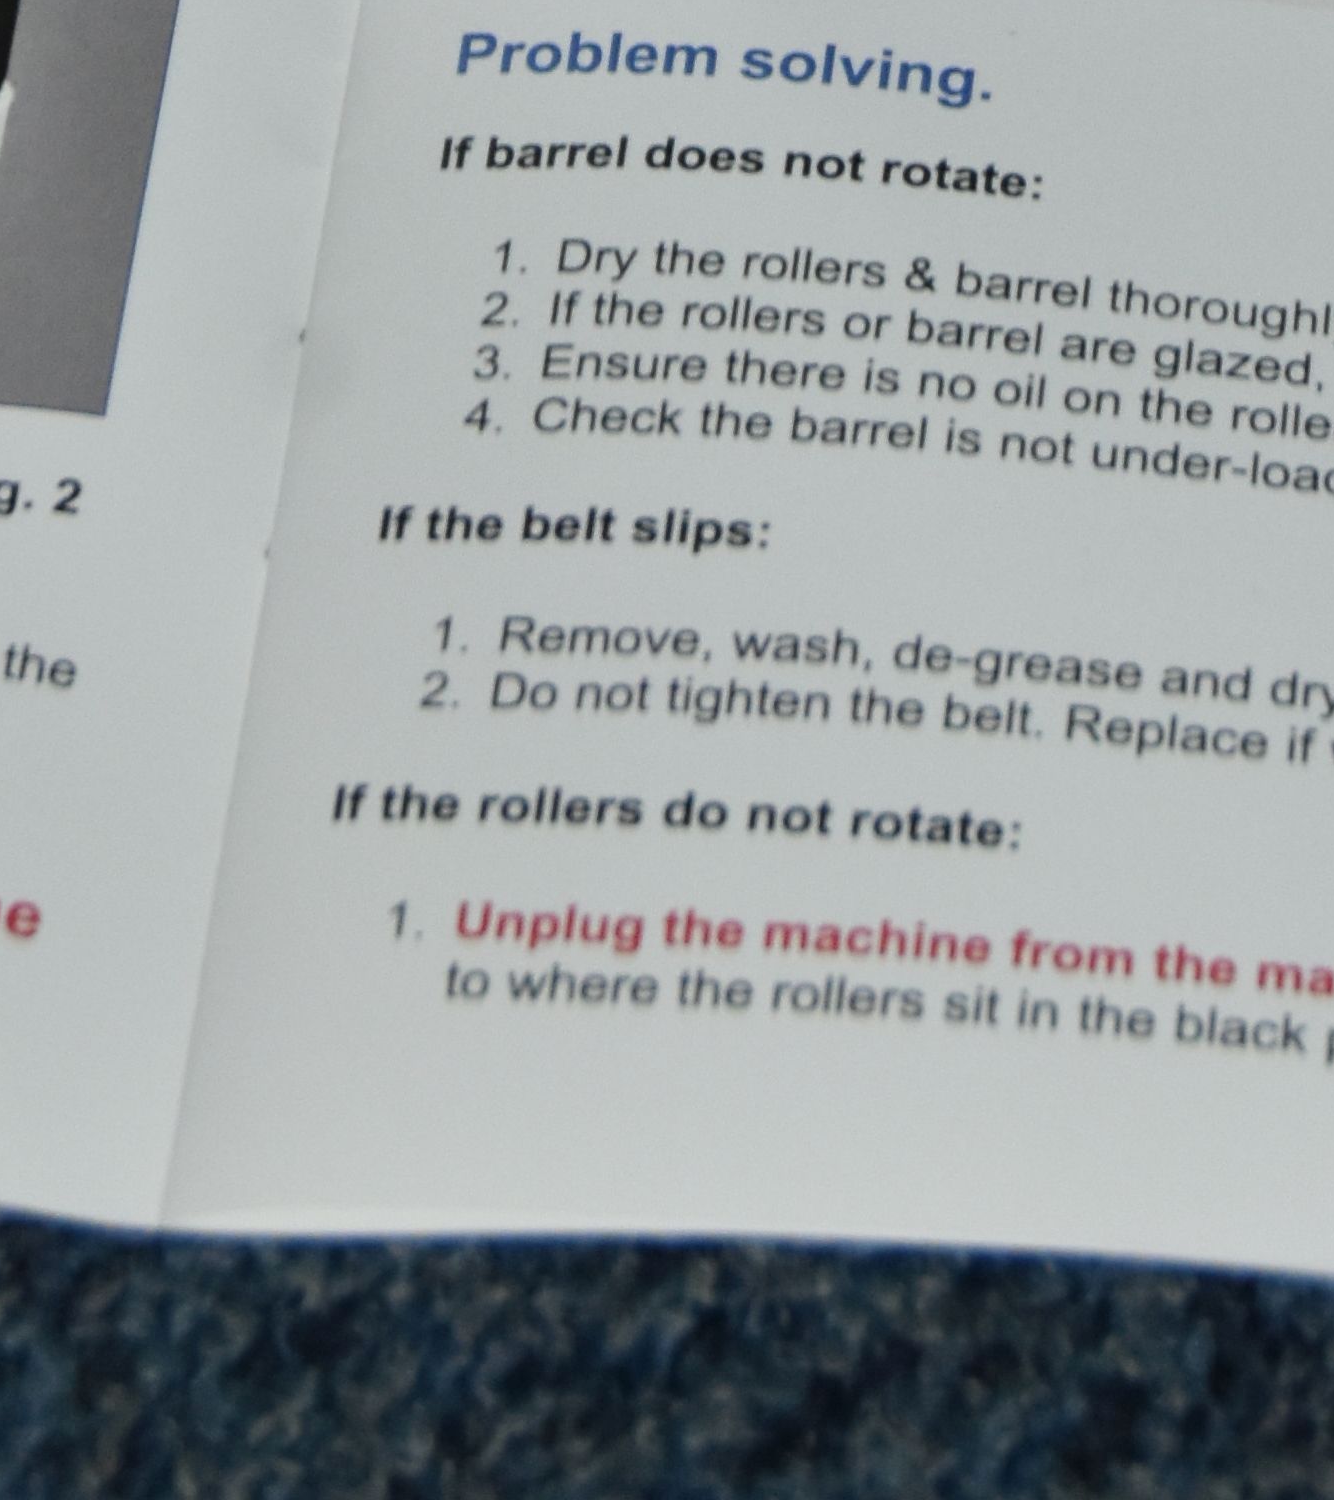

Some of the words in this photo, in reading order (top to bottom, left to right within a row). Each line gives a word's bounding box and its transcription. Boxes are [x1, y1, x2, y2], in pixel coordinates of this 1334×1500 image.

[455, 30, 719, 78] Problem
[740, 42, 992, 110] solving.
[439, 135, 475, 171] If
[485, 134, 630, 170] barrel
[643, 135, 766, 175] does
[783, 150, 866, 183] not
[880, 158, 1043, 201] rotate:
[52, 477, 83, 516] 2
[378, 504, 414, 542] If
[426, 505, 505, 542] the
[520, 505, 616, 544] belt
[632, 508, 770, 555] slips:
[332, 783, 367, 822] If
[381, 784, 461, 822] the
[477, 786, 644, 827] rollers
[662, 790, 730, 830] do
[746, 800, 833, 837] not
[849, 807, 1020, 850] rotate:
[388, 900, 423, 940] 1.
[455, 901, 645, 956] Unplug
[663, 908, 745, 950] the
[762, 919, 992, 965] machine
[1011, 929, 1135, 978] from
[1154, 944, 1237, 988] the
